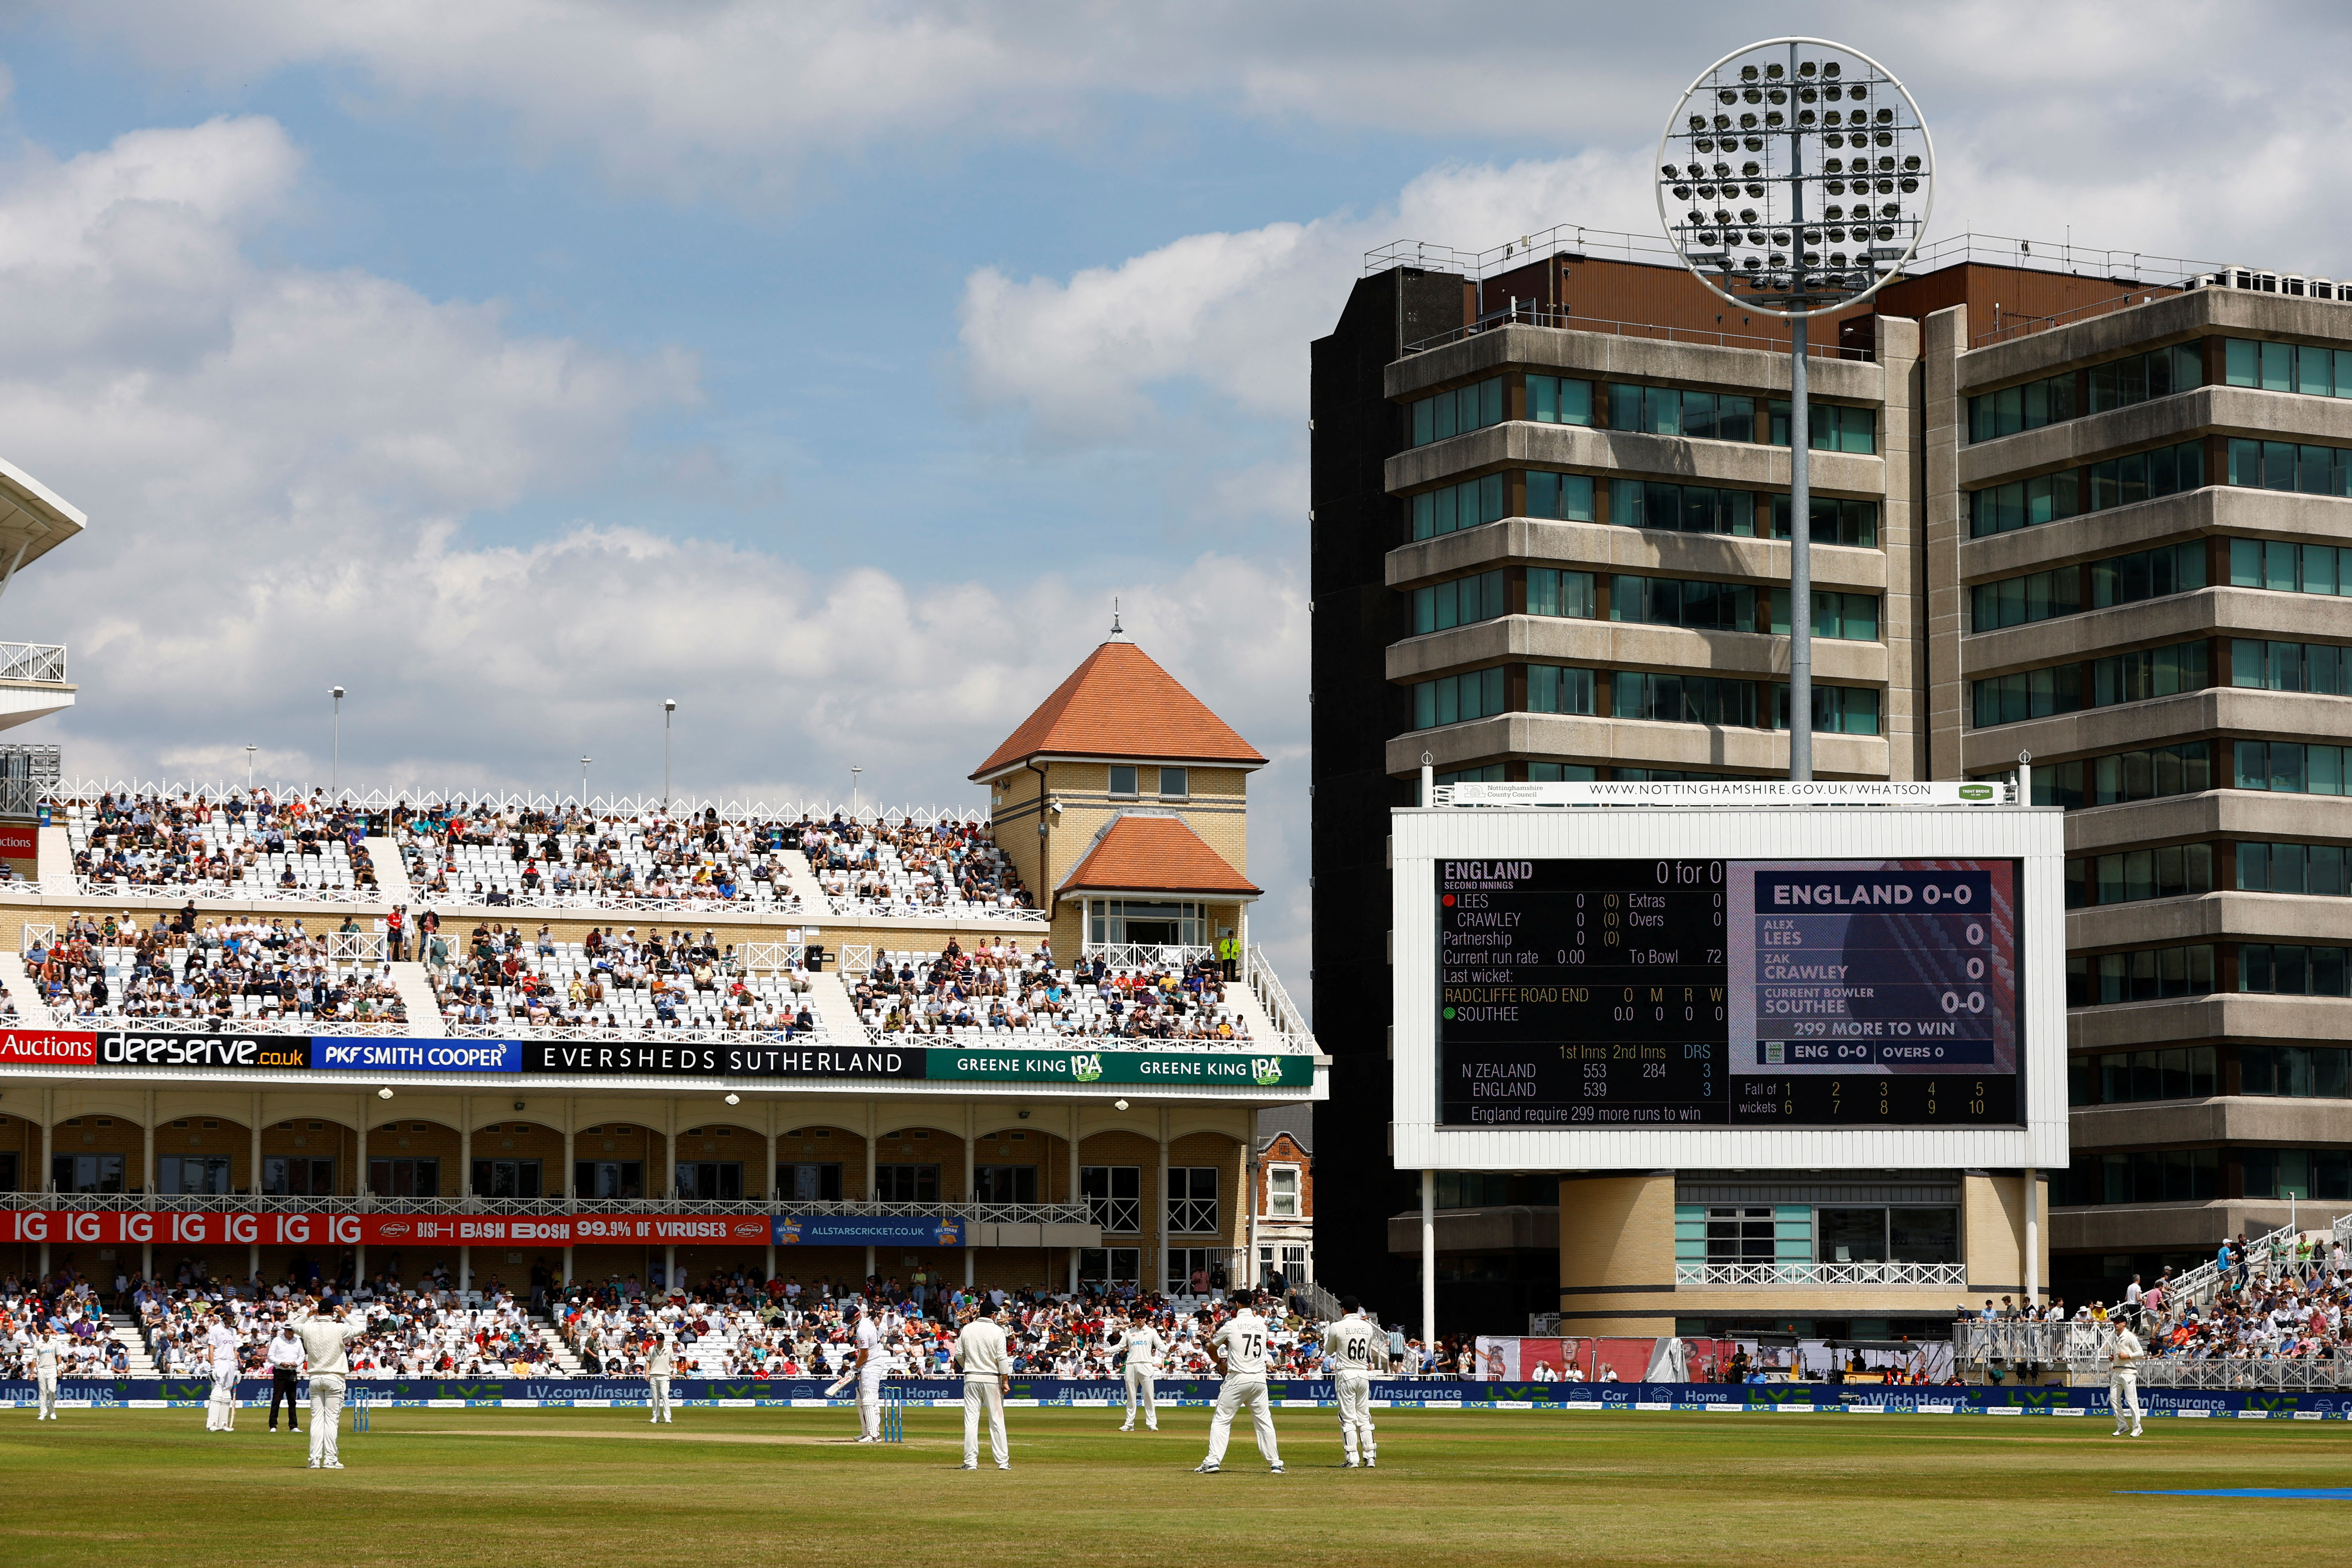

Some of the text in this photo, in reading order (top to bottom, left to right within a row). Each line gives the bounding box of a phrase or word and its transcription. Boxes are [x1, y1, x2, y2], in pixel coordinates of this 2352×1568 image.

[1590, 784, 1930, 795] WWW.NOTTINGHAMSHIRE.GOV.UK/WHATSON
[1445, 862, 1532, 879] ENGLAND
[1657, 861, 1721, 883] 0 for 0
[1457, 894, 1619, 909] LEES 0 (0)
[1629, 893, 1720, 907] Extras 0
[1774, 884, 1972, 905] ENGLAND 0-0
[1457, 912, 1619, 928] CRAWLEY 0 (0)
[1630, 912, 1721, 926] Overs 0
[1764, 920, 1794, 929] ALEX
[1444, 931, 1619, 948] Partnership 0 (0)
[1764, 931, 1802, 945] LEES
[1966, 924, 1984, 945] 0
[1444, 950, 1584, 964] Current run rate 0.00
[1629, 949, 1721, 964] To Bowl 72
[1764, 954, 1790, 964] ZAK
[1444, 969, 1513, 982] Last wicket:
[1764, 965, 1849, 979] CRAWLEY
[1967, 958, 1984, 979] 0
[1445, 988, 1588, 1002] RADCLIFFE ROAD END
[1651, 988, 1662, 1002] M
[1685, 988, 1692, 1002] R
[1710, 988, 1722, 1002] W
[1765, 988, 1874, 998] CURRENT BOWLER
[1765, 1000, 1845, 1013] SOUTHEE
[1942, 991, 1985, 1013] 0-0
[1458, 1007, 1722, 1021] SOUTHEE 0.0 0 0 0
[1794, 1022, 1955, 1035] 299 MORE TO WIN
[1, 1034, 92, 1058] Auctions
[1560, 1045, 1710, 1059] 1st Inns 2nd Inns DRS
[1795, 1045, 1867, 1058] ENG 0-0
[1883, 1047, 1944, 1058] OVERS 0
[326, 1046, 502, 1067] PKF SMITH COOPER
[544, 1048, 902, 1072] EVERSHEDS SUTHERLAND
[957, 1054, 1103, 1075] GREENE KING IPA
[1140, 1058, 1283, 1078] GREENE KING IPA
[1463, 1063, 1711, 1078] N ZEALAND 553 284 3
[1473, 1082, 1711, 1096] ENGLAND 539 3
[1745, 1083, 1777, 1095] Fall of
[1785, 1082, 1984, 1096] 1 2 3 4 5
[1472, 1106, 1700, 1123] England require 299 more runs to win
[1739, 1102, 1777, 1113] wickets
[1785, 1100, 1984, 1114] 6 7 8 9 10
[15, 1212, 47, 1241] IG
[67, 1212, 100, 1241] IG
[120, 1213, 153, 1242] IG
[173, 1214, 206, 1242] IG
[225, 1214, 258, 1243] IG
[277, 1215, 310, 1243] IG
[328, 1215, 361, 1243] IG
[417, 1221, 726, 1240] BISH BASH BOSH 99.9% OF VIRUSES
[811, 1227, 924, 1236] ALLSTARSCRICKET.CO.UK
[1242, 1334, 1261, 1358] 75
[1348, 1338, 1366, 1361] 66
[1602, 1390, 1628, 1401] Car
[1685, 1390, 1727, 1402] Home
